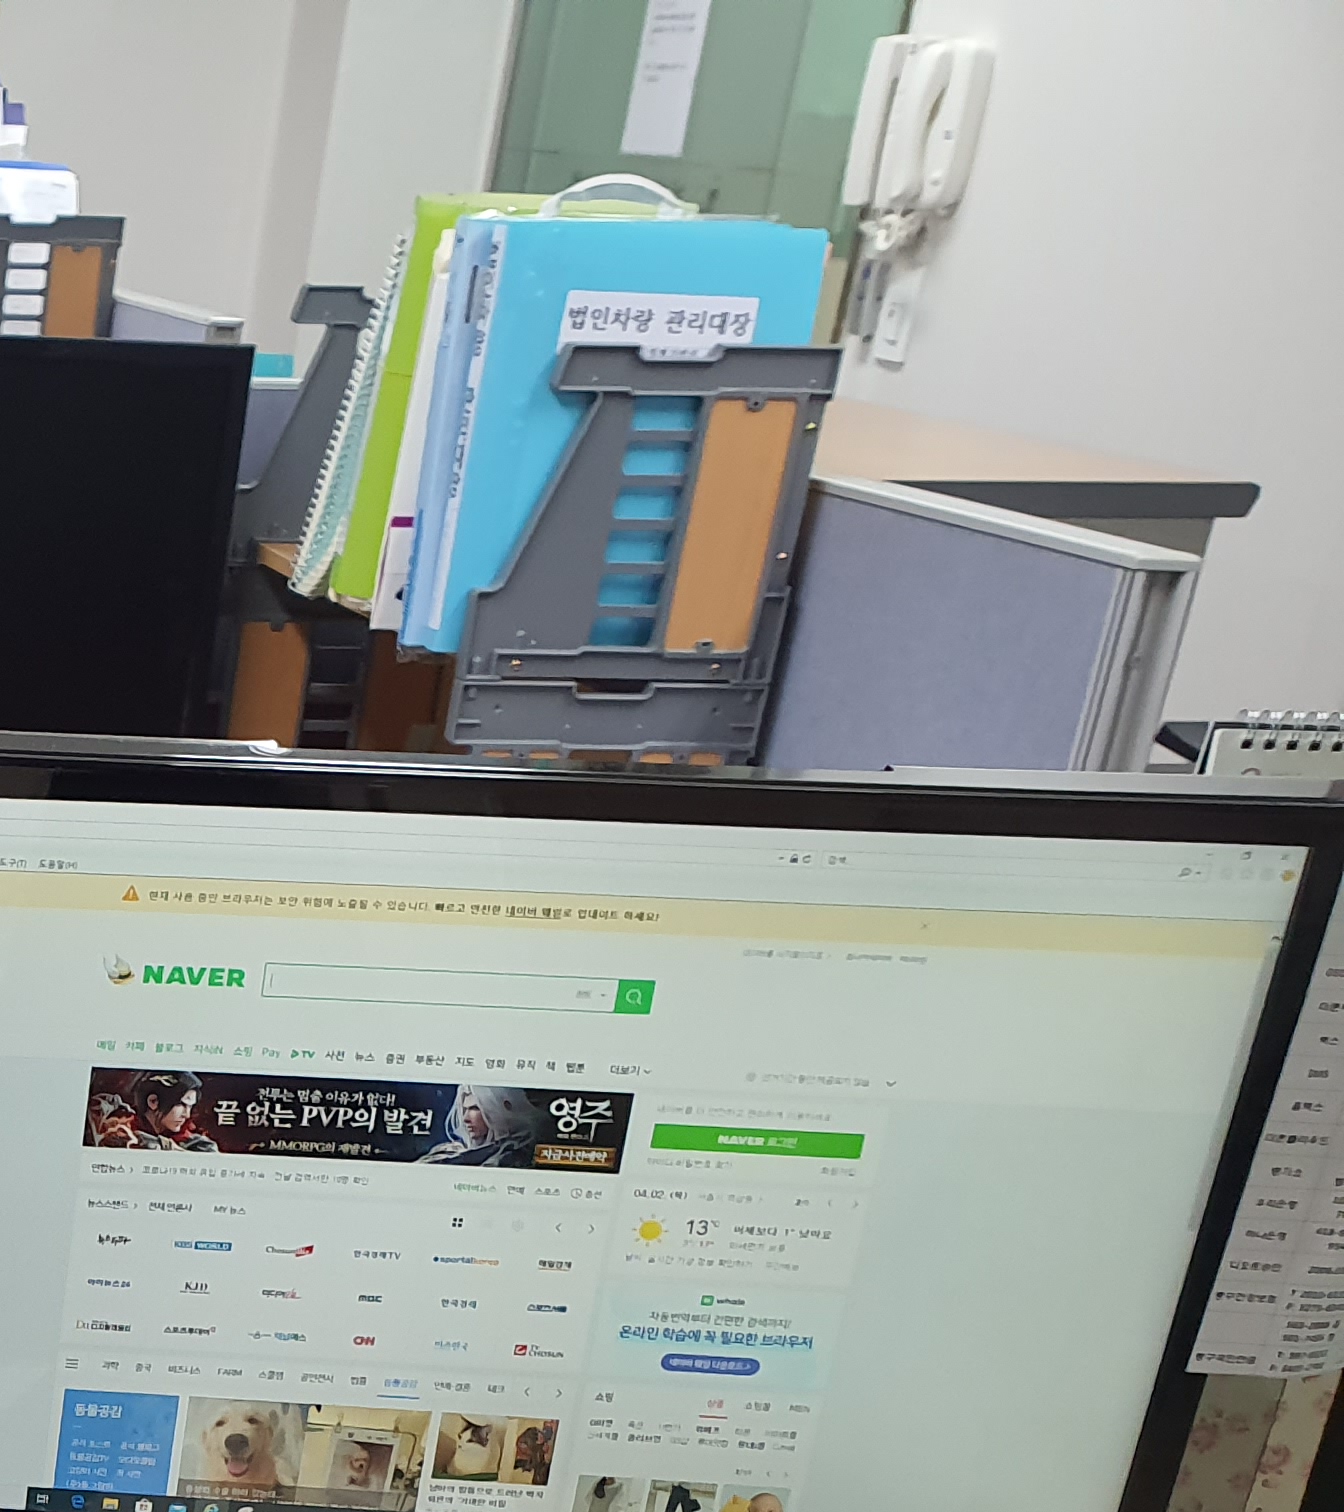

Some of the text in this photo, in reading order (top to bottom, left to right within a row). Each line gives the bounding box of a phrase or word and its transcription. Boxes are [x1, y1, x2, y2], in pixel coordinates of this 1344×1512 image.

[568, 306, 753, 338] 법인차량 관리대장
[142, 965, 246, 988] NAVER
[262, 1048, 281, 1060] Pay
[354, 1051, 375, 1063] 뉴스
[415, 1054, 445, 1067] 부동산
[455, 1056, 475, 1068] 지도
[610, 1064, 640, 1077] 더보기
[326, 1090, 363, 1107] 이유가
[366, 1092, 396, 1108] 없다!
[213, 1099, 432, 1137] 끝 없는 PVP의 발견
[548, 1097, 614, 1141] 영주
[686, 1219, 709, 1236] 13
[619, 1325, 814, 1349] 온라인 학습에 필요한 브라우저
